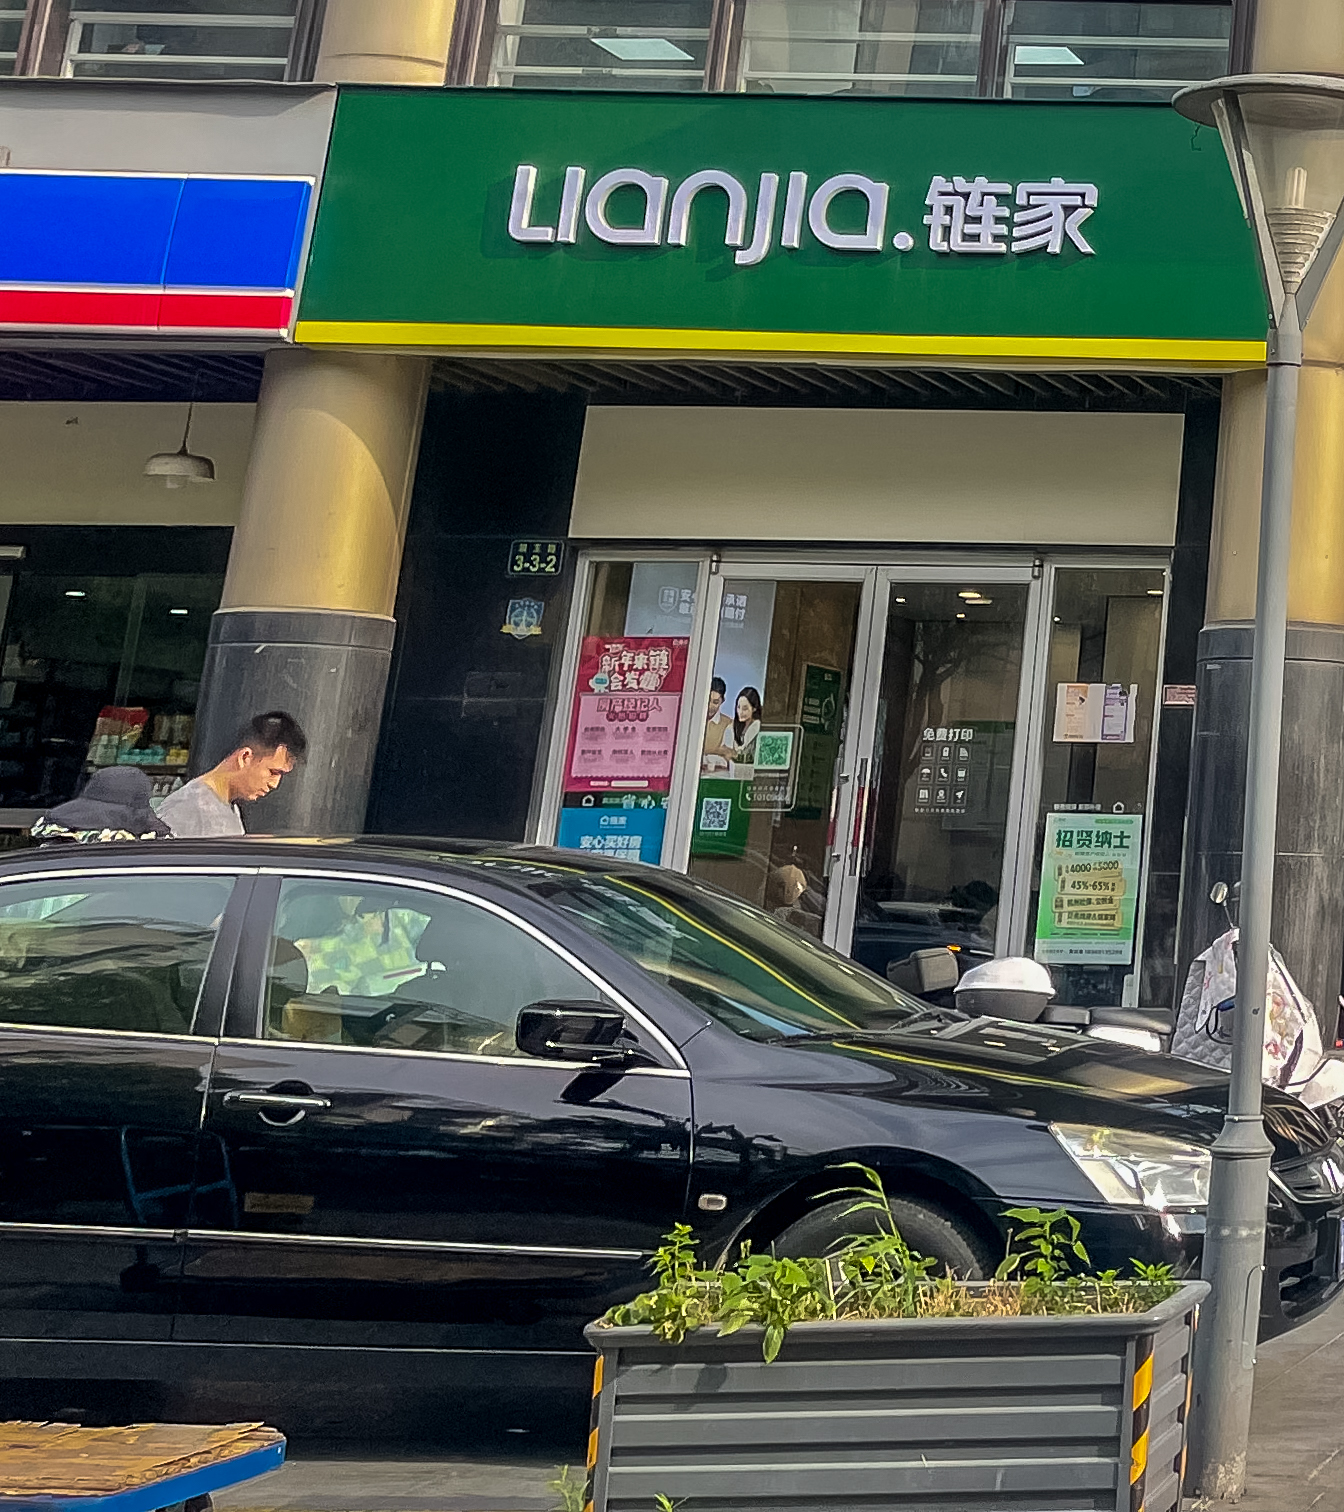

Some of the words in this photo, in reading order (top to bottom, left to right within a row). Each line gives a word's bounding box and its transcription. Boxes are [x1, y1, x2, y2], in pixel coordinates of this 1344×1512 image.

[922, 176, 1099, 255] 链家
[513, 554, 557, 573] 3-3-2
[923, 728, 974, 741] 免费打印
[580, 835, 642, 849] 安心买好房
[1055, 829, 1132, 849] 招贤纳士
[1070, 863, 1092, 873] 4000
